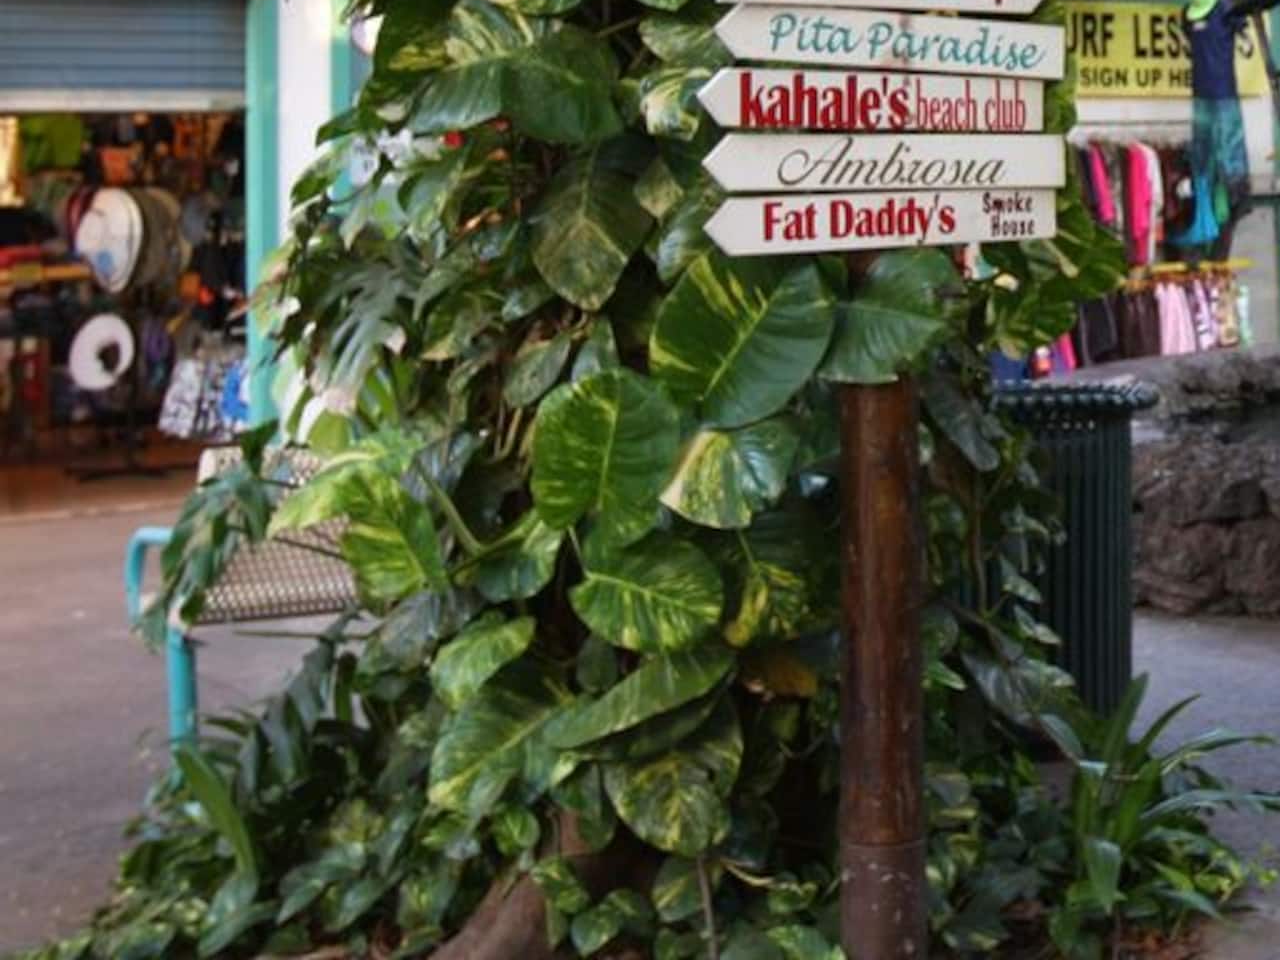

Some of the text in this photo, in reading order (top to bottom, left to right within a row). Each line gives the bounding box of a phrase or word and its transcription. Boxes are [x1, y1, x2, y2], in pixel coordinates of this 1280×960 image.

[769, 12, 1047, 71] Pita Paradise
[1066, 12, 1115, 59] URF
[740, 72, 1027, 132] kahale's beach club
[1079, 67, 1193, 88] SIGN UP HE
[777, 136, 1006, 187] Ambrosia
[762, 194, 957, 246] Fat Daddy's
[982, 191, 1034, 214] Smoke
[991, 216, 1036, 237] House
